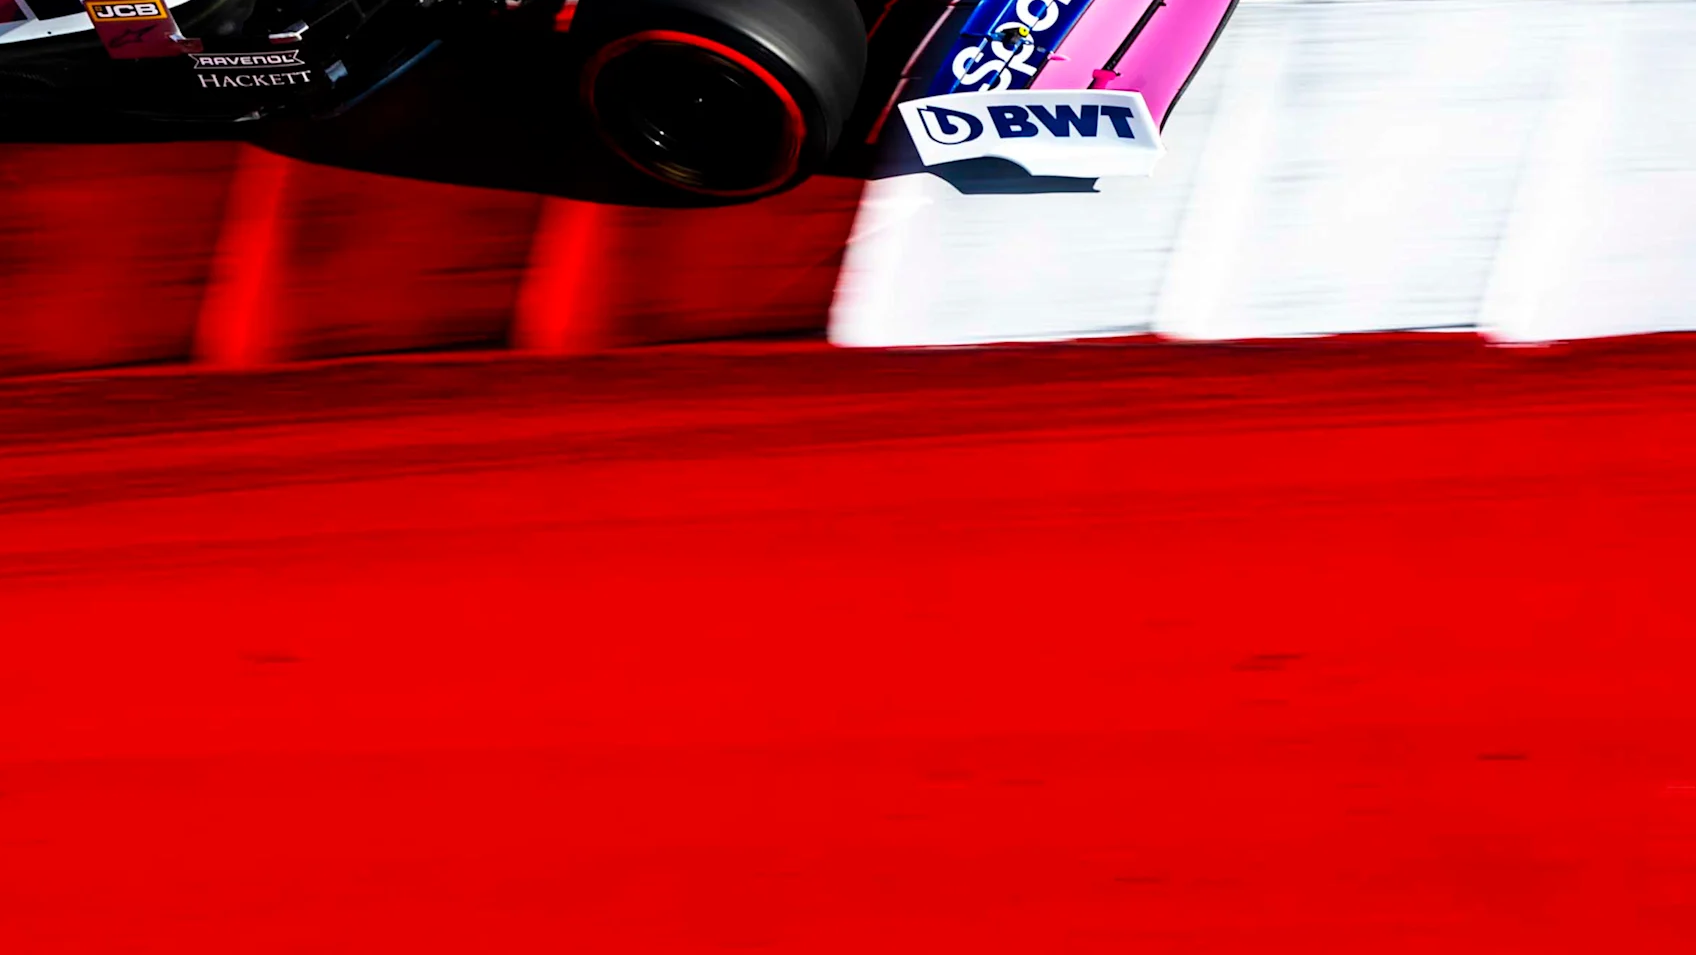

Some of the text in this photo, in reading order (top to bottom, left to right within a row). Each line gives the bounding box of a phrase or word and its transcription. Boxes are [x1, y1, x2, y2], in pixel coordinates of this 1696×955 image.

[97, 3, 159, 17] JCB
[198, 53, 295, 66] RAVENOL
[198, 70, 312, 88] HACKETT
[986, 104, 1135, 139] BWT
